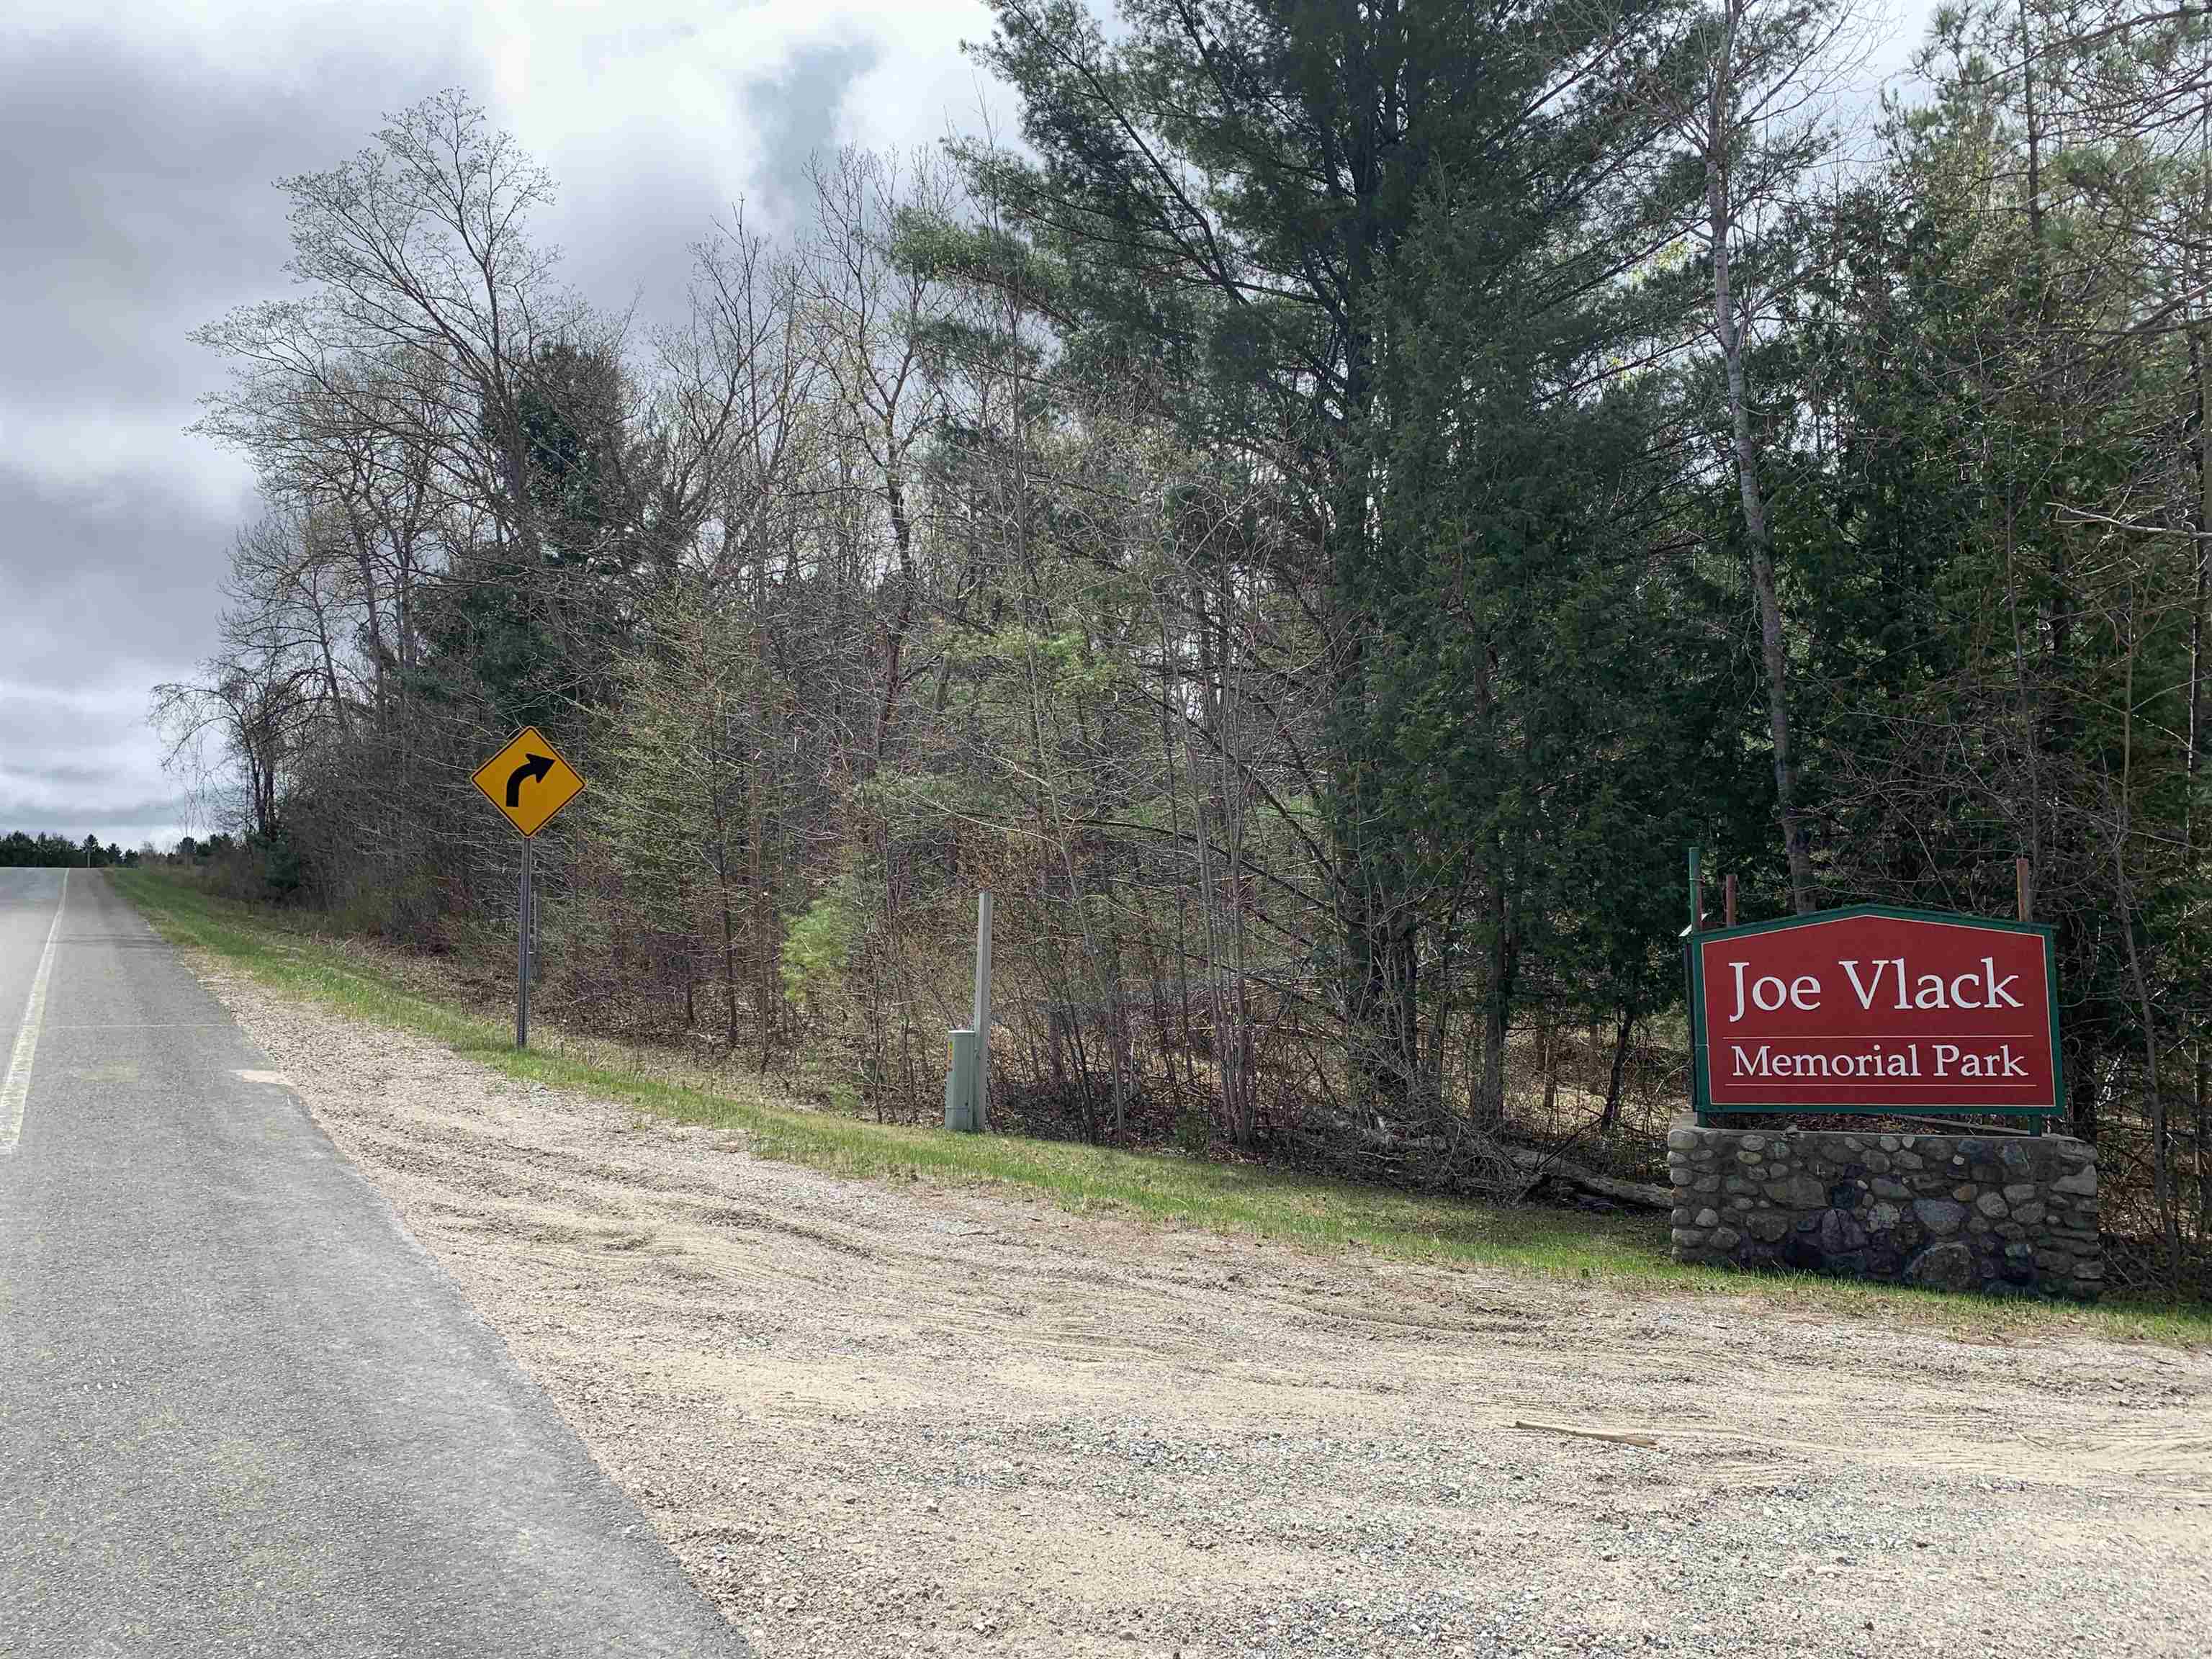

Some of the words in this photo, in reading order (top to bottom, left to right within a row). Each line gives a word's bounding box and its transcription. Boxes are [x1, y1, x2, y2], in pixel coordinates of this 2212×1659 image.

[1729, 961, 1821, 1022] Joe
[1838, 956, 2024, 1010] Vlack
[1731, 1044, 1922, 1076] Memorial
[1932, 1044, 2029, 1076] Park
